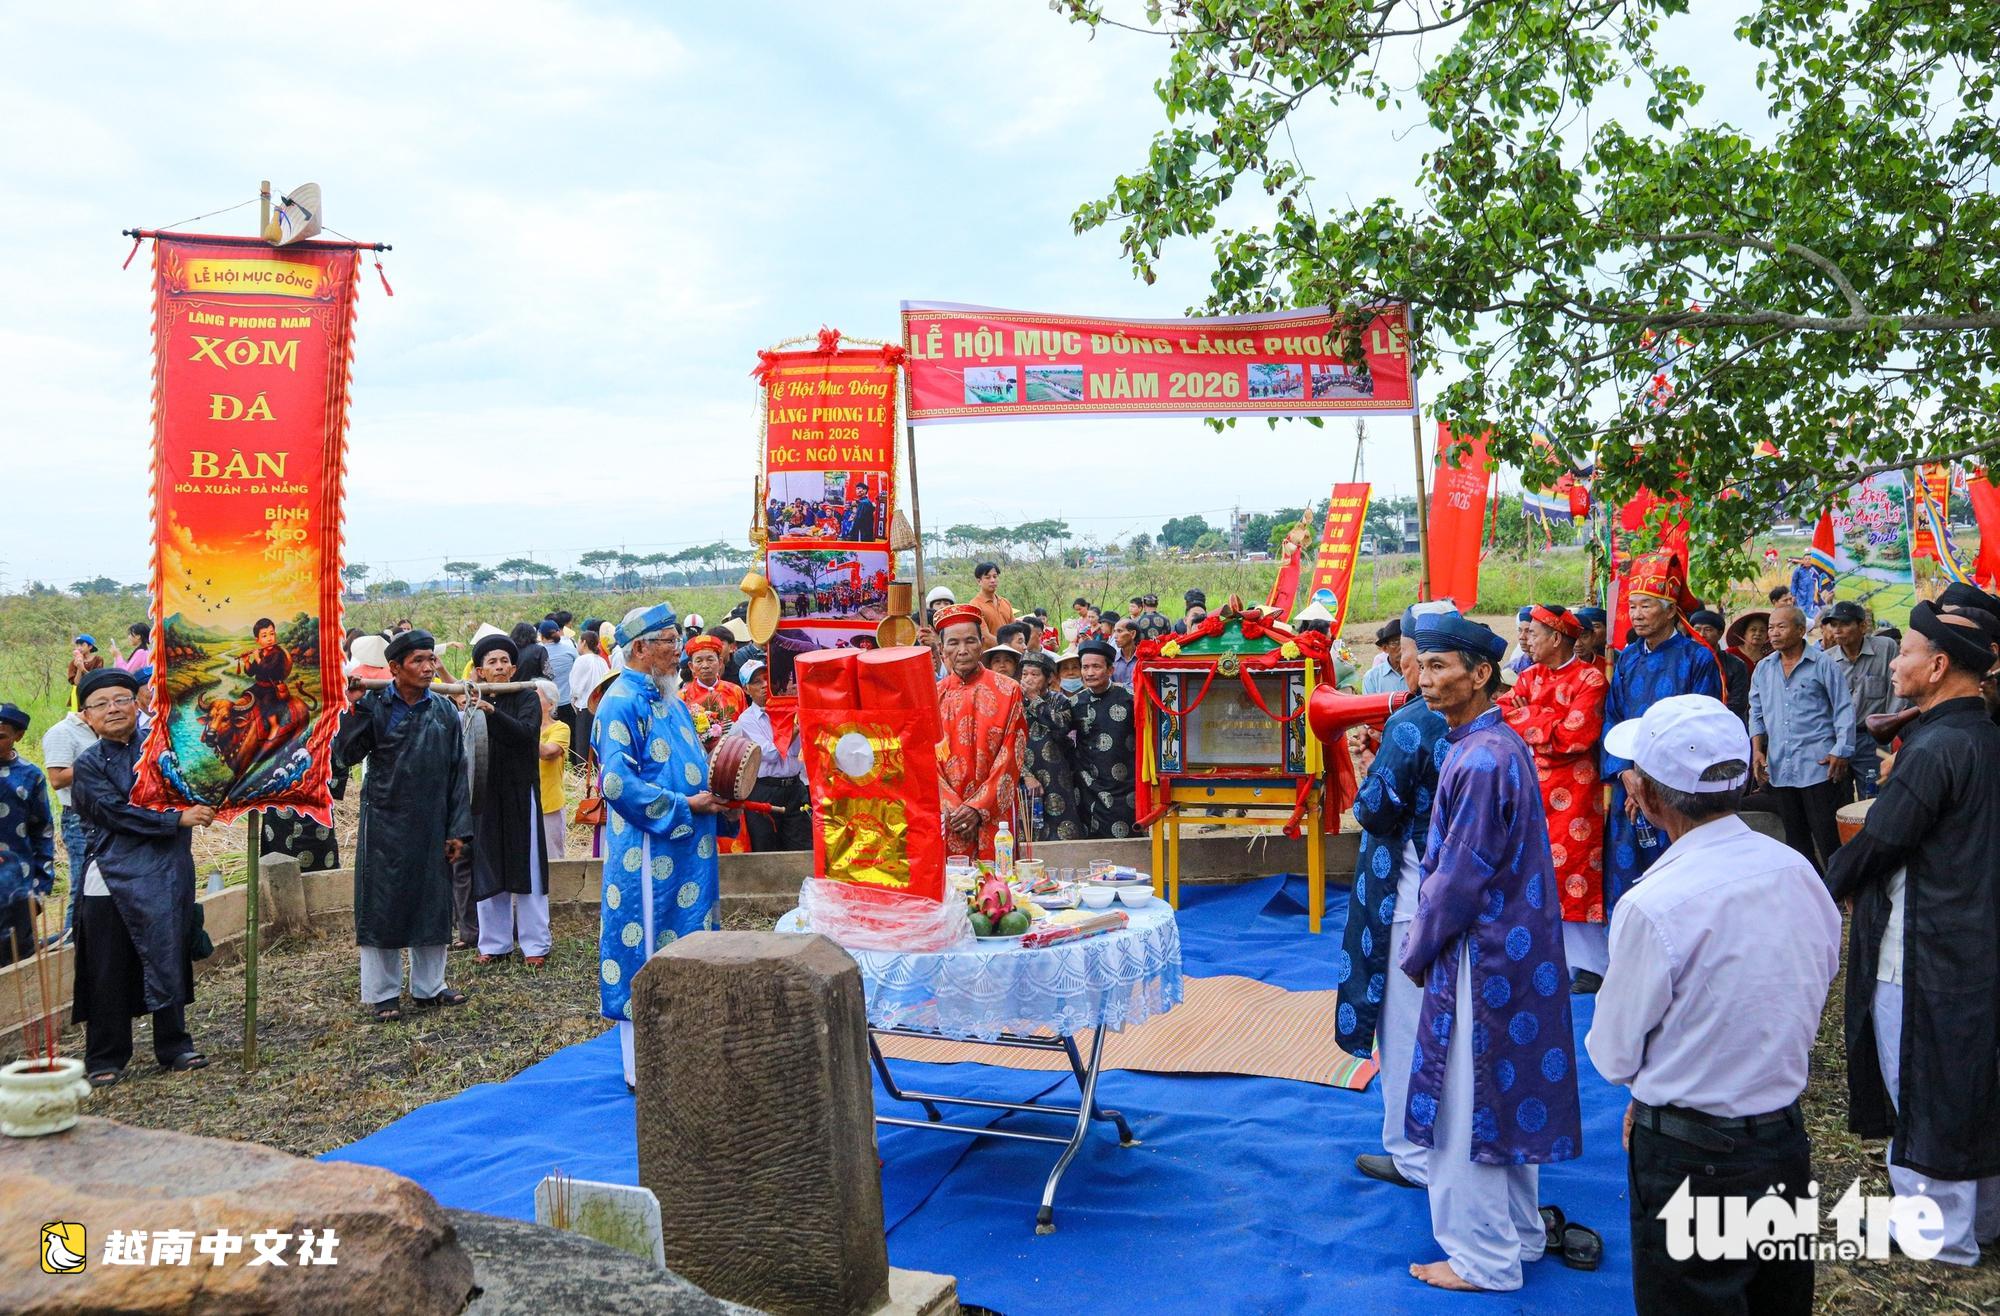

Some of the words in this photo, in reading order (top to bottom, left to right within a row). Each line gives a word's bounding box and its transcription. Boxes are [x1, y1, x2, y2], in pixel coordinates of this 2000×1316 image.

[194, 266, 210, 283] LỄ
[214, 269, 239, 284] HỘI
[242, 271, 273, 285] MỤC
[275, 270, 313, 289] ĐỒNG
[188, 310, 225, 326] LÀNG
[229, 316, 277, 328] PHONG
[281, 317, 311, 328] NAM
[911, 324, 944, 360] LỄ
[954, 326, 1004, 363] HỘI
[1015, 331, 1082, 361] MỤC
[1091, 330, 1173, 355] ĐỒNG
[1179, 334, 1257, 355] LÀNG
[1264, 334, 1356, 357] PHON
[1371, 322, 1407, 359] LỆ
[189, 336, 300, 371] XÓM
[771, 381, 785, 400] Lễ
[788, 381, 815, 397] Hội
[817, 381, 845, 398] Mục
[849, 380, 888, 399] Đồng
[1090, 368, 1159, 399] NĂM
[1169, 372, 1240, 398] 2026
[208, 391, 277, 421] ĐÁ
[769, 406, 807, 424] LÀNG
[812, 406, 863, 423] PHONG
[867, 404, 887, 427] LỆ
[792, 428, 824, 440] Năm
[829, 428, 860, 440] 2026
[188, 448, 289, 479] BÀN
[770, 446, 801, 466] TỘC:
[806, 445, 838, 462] NGÔ
[842, 445, 873, 462] VĂN
[174, 482, 201, 493] HÒA
[204, 483, 241, 494] XUÂN
[250, 483, 268, 494] ĐÀ
[271, 480, 309, 494] NẴNG
[1447, 491, 1471, 511] 2026
[265, 504, 309, 520] BÍNH
[265, 528, 308, 544] NGỌ
[264, 545, 309, 561] NIÊN
